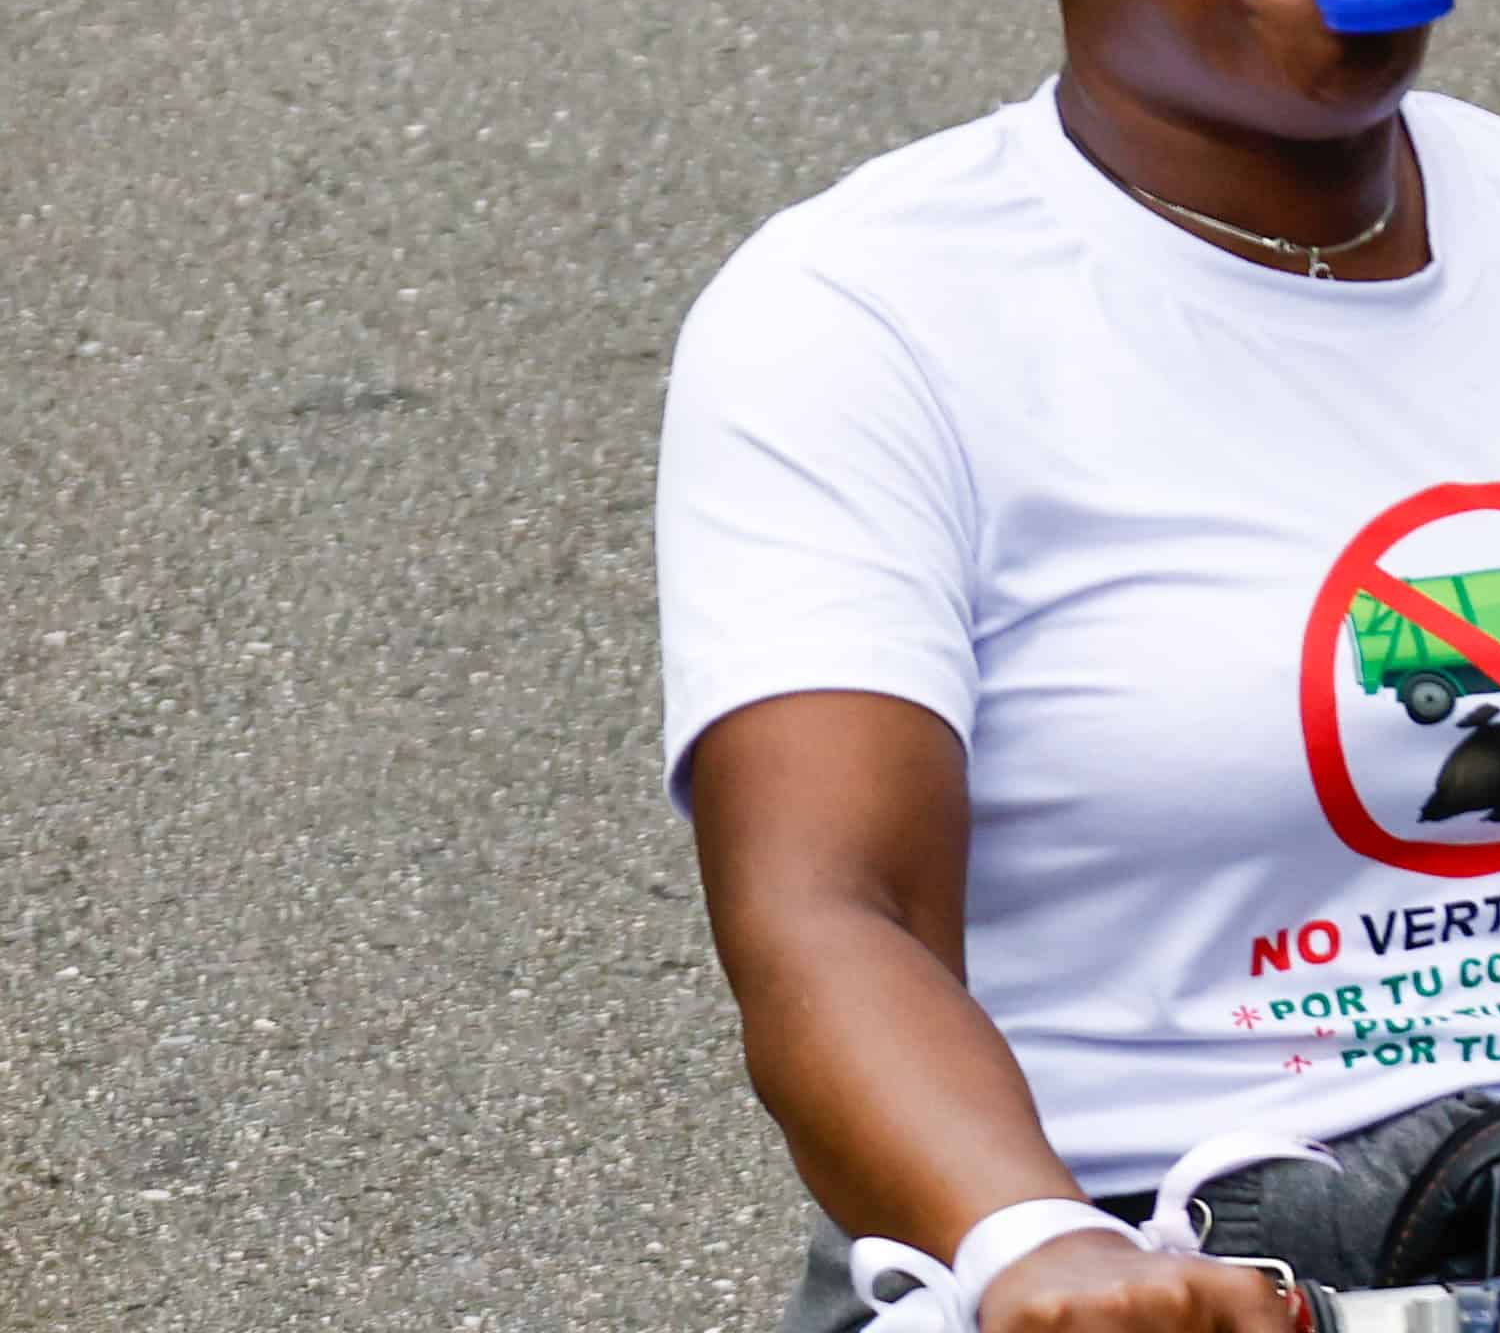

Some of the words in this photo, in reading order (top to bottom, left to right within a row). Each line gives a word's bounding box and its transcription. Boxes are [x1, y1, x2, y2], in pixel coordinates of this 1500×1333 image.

[1250, 919, 1341, 978] NO
[1269, 985, 1368, 1021] POR
[1379, 965, 1444, 1006] TU
[1340, 1035, 1437, 1069] POR
